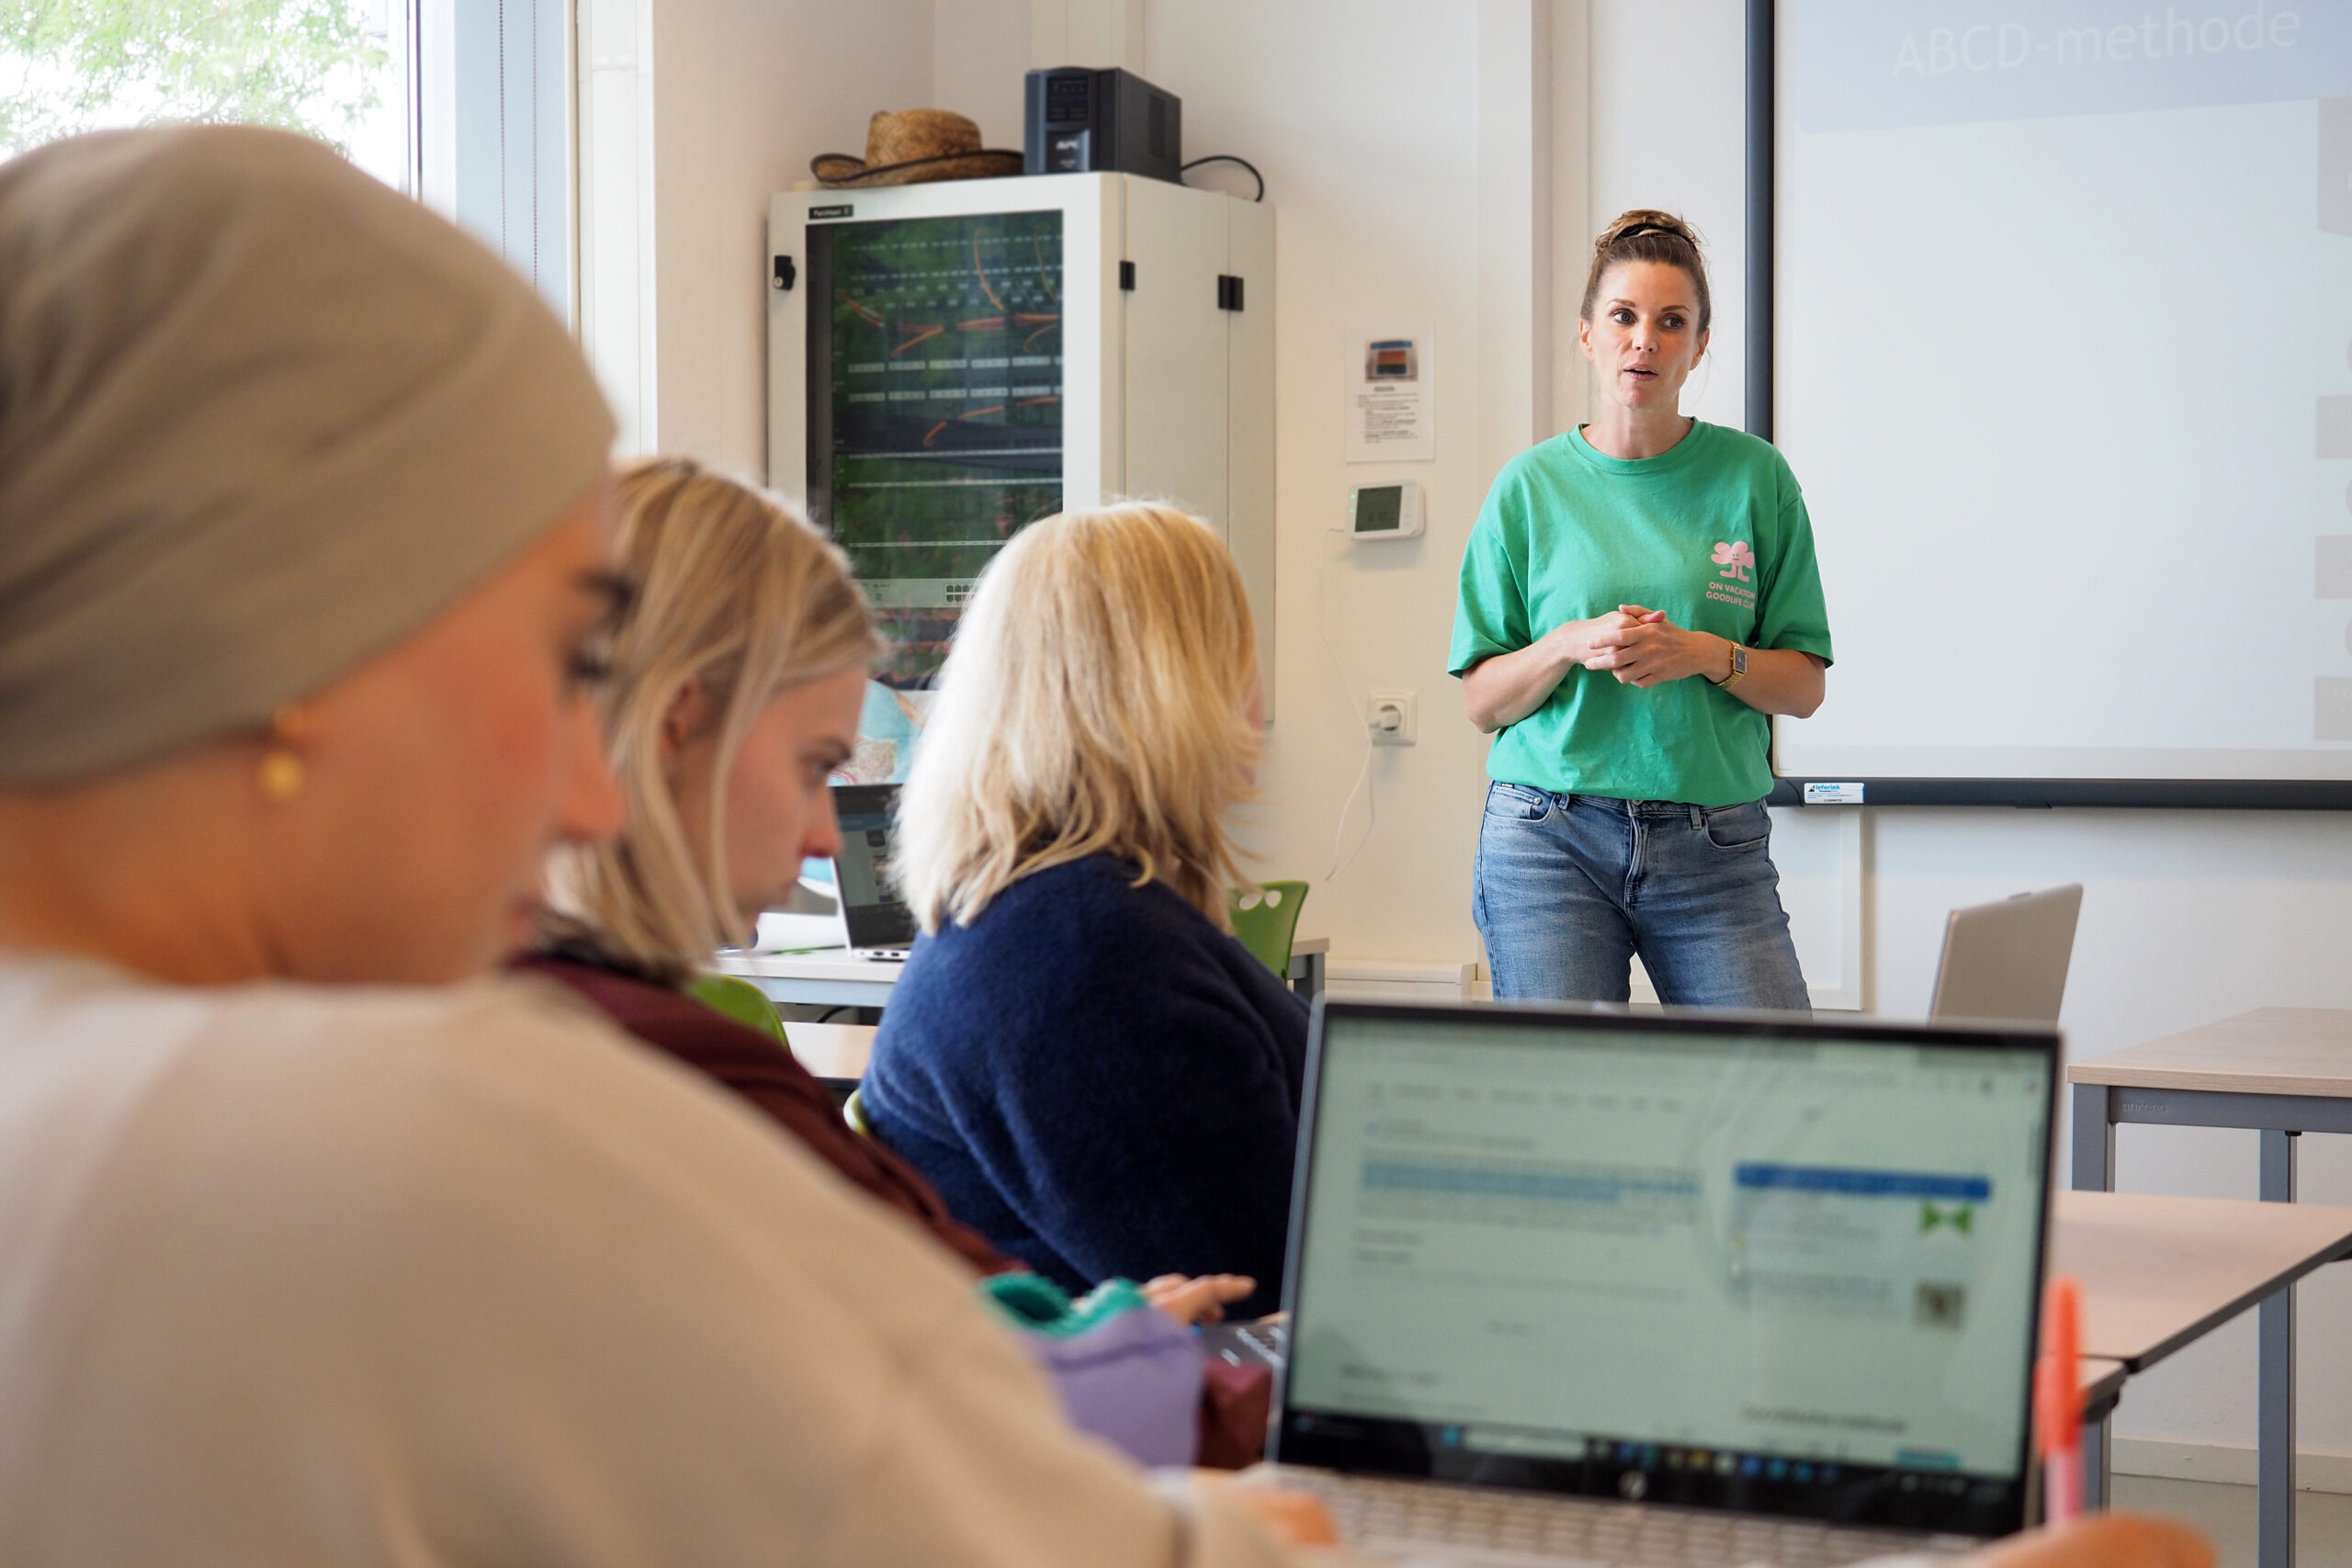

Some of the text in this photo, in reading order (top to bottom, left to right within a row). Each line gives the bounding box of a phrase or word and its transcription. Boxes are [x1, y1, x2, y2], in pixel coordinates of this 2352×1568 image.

[1892, 0, 2301, 76] ABCD-methode
[1705, 591, 1742, 606] GOODLIFE
[1709, 581, 1756, 600] ON VACATION
